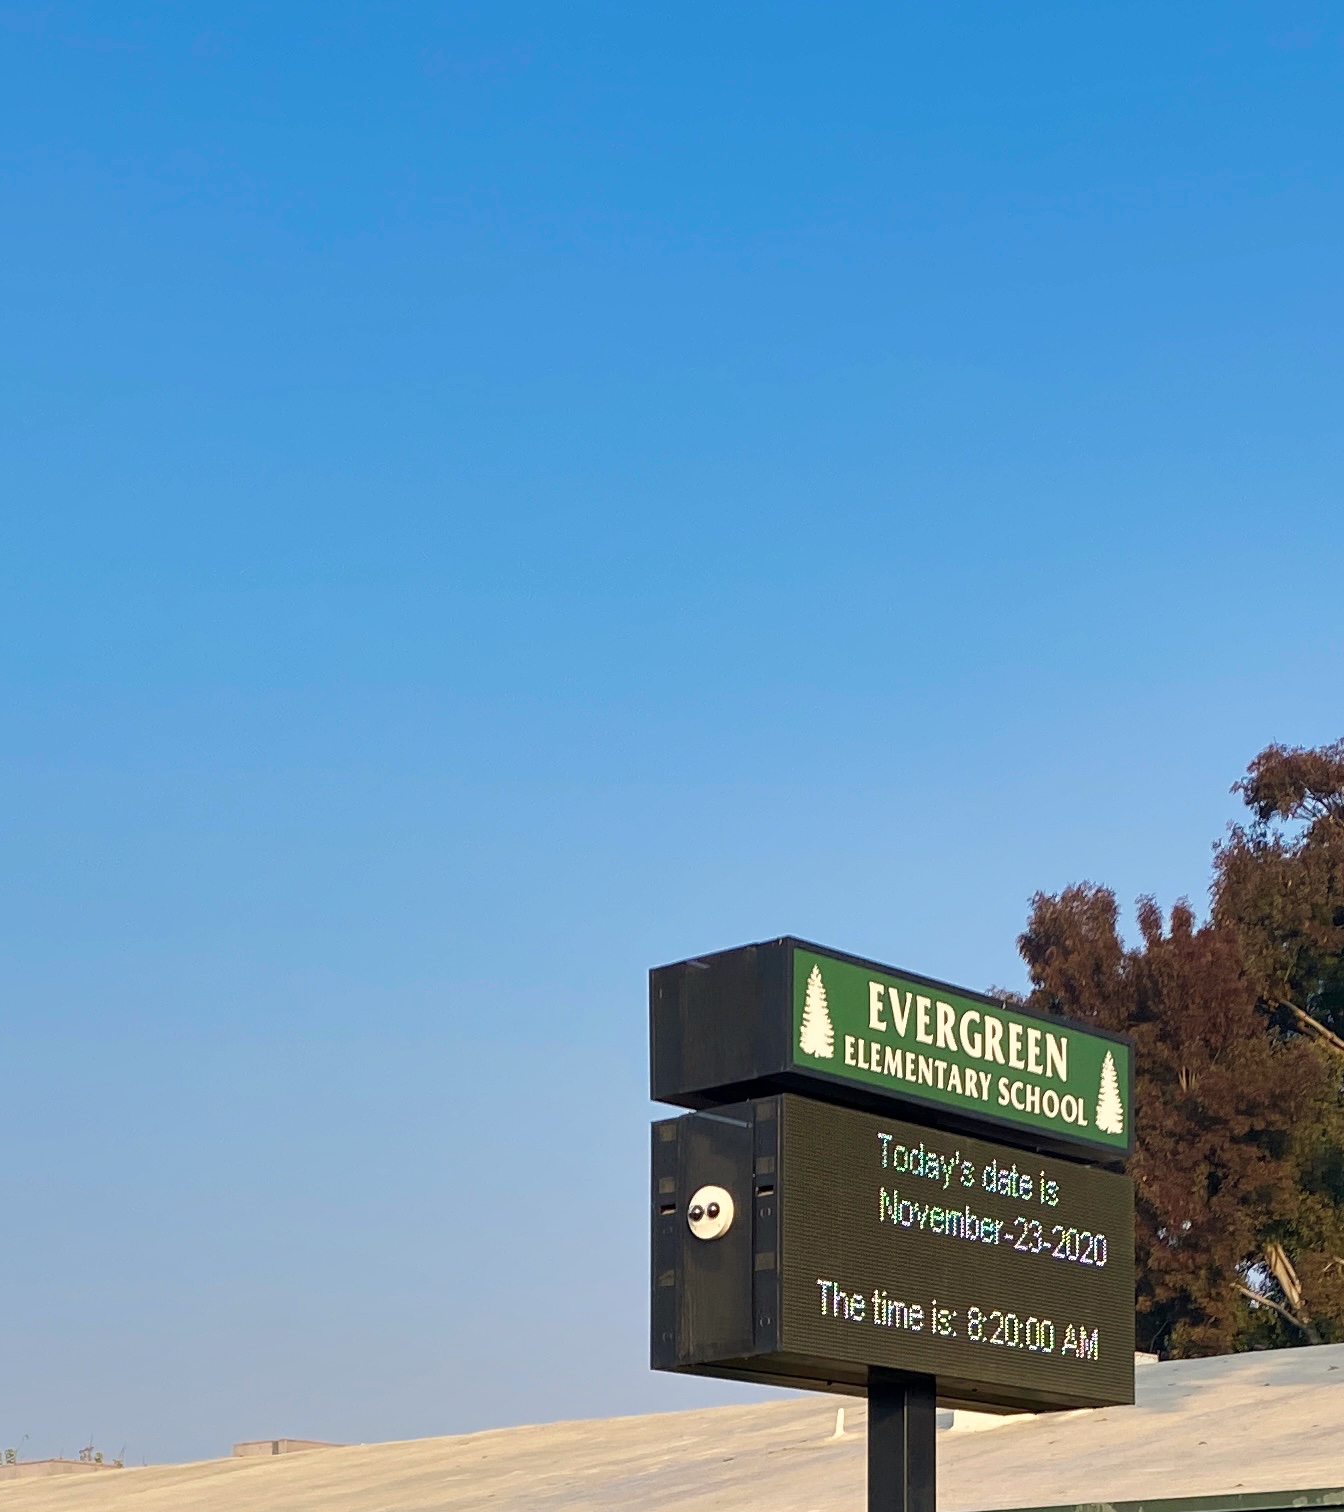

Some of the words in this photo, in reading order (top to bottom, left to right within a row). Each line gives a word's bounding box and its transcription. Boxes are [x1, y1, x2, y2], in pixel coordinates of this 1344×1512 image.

[867, 980, 1069, 1083] EVERGREEN
[844, 1033, 992, 1102] ELEMENTARY
[997, 1075, 1088, 1127] SCHOOL
[877, 1132, 975, 1190] Today's
[982, 1159, 1032, 1203] date
[1039, 1170, 1060, 1207] is
[878, 1187, 1108, 1267] November-23-2020
[816, 1278, 866, 1322] The
[871, 1289, 924, 1332] time
[931, 1299, 957, 1338] is:
[967, 1306, 1055, 1353] 8:20:00
[1061, 1322, 1100, 1361] AM
